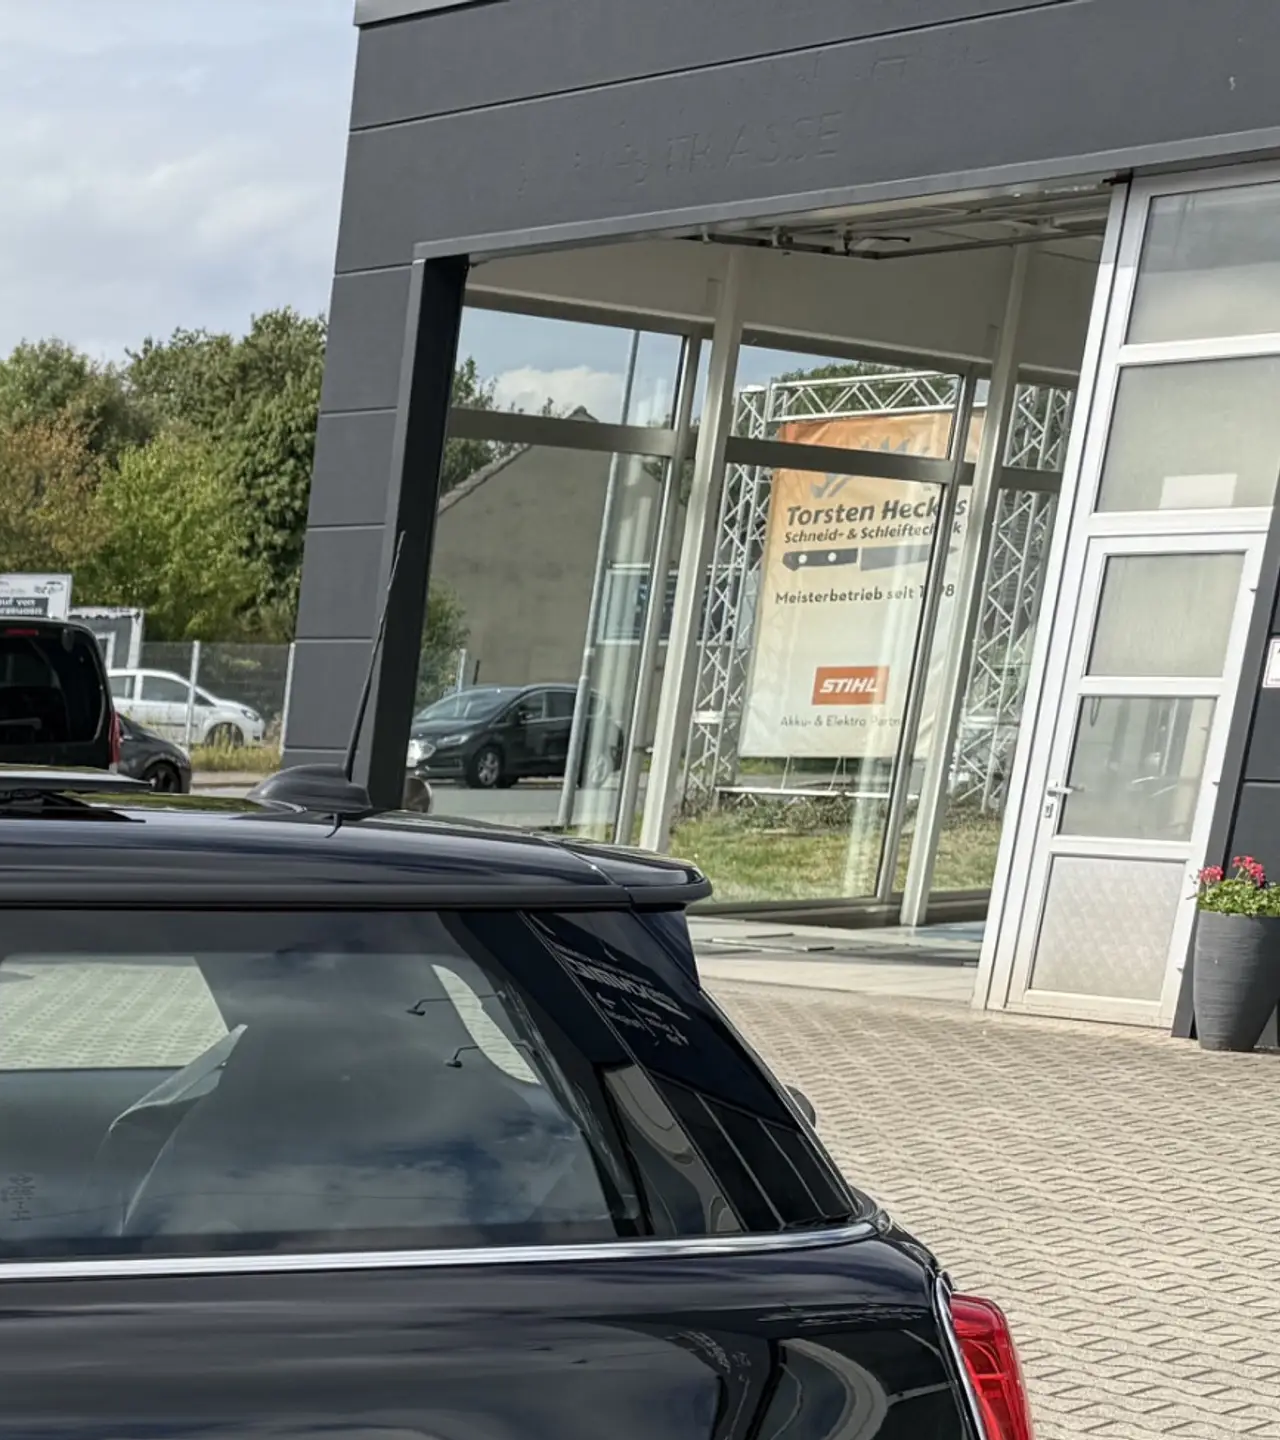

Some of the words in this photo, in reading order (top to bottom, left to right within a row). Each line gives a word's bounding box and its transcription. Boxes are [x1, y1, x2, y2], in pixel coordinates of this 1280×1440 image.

[787, 504, 875, 526] Torsten
[784, 528, 844, 543] Schneid-
[847, 528, 857, 540] &
[861, 521, 962, 540] Schleiftechk
[775, 586, 883, 604] Meisterbetrieb
[887, 585, 915, 600] seit
[819, 677, 880, 693] STIHL
[780, 715, 811, 728] Akku-
[814, 714, 823, 727] &
[826, 714, 867, 727] Elektro
